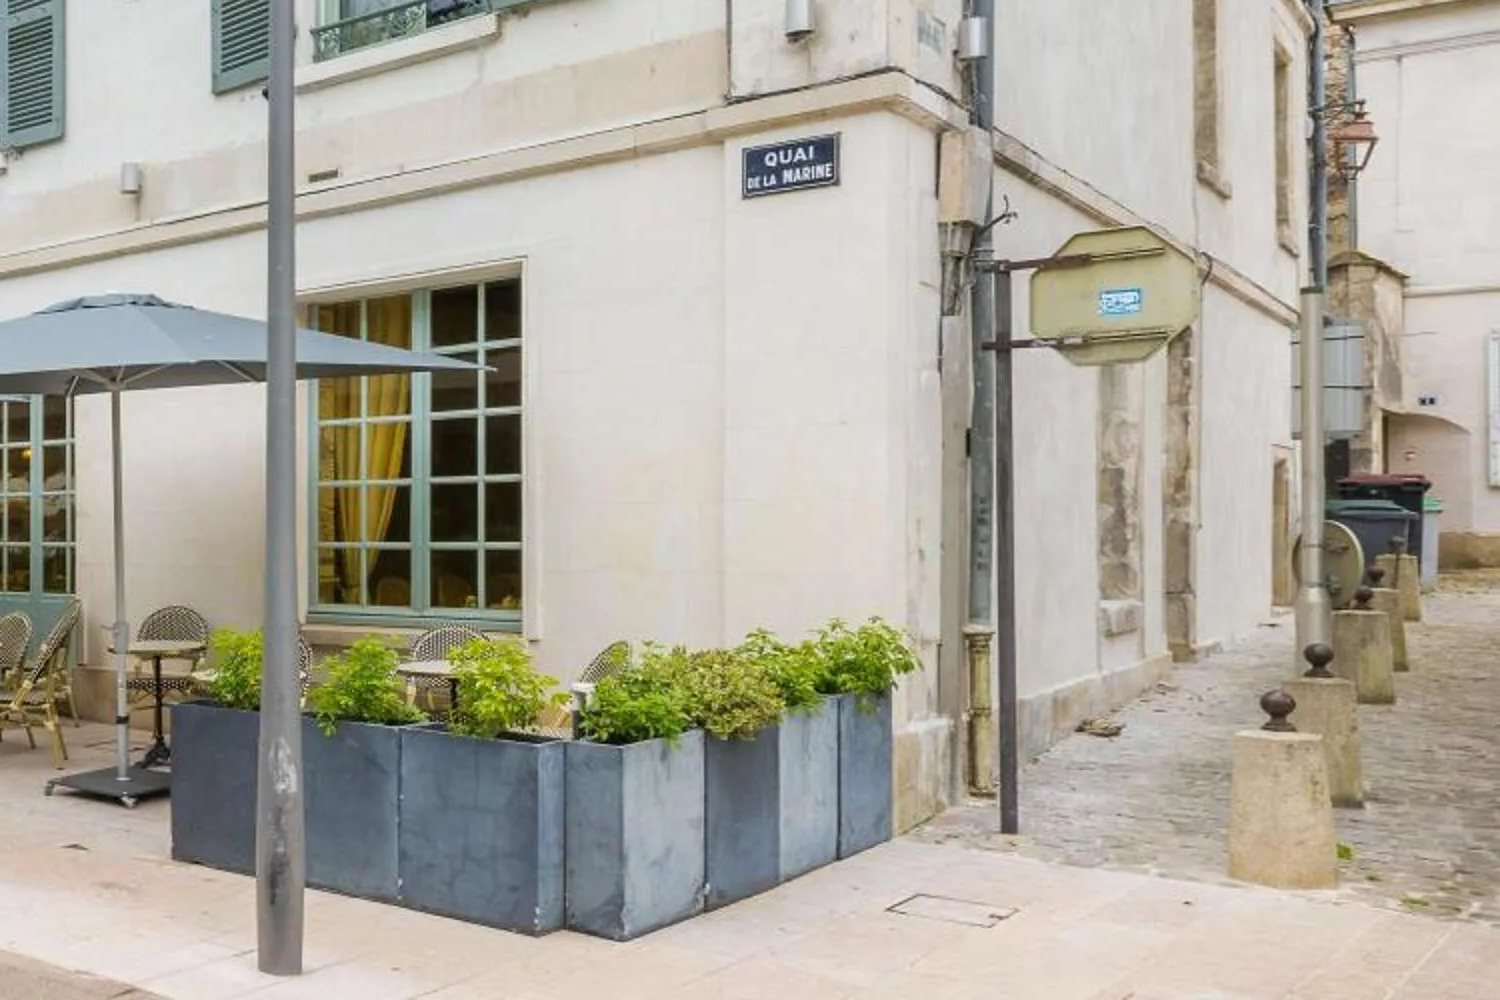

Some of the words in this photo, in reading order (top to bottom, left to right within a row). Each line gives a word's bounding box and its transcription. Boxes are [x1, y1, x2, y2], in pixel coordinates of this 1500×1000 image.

[764, 145, 814, 167] QUAI
[747, 176, 761, 189] DE
[763, 173, 777, 187] LA
[782, 163, 833, 184] MARINE
